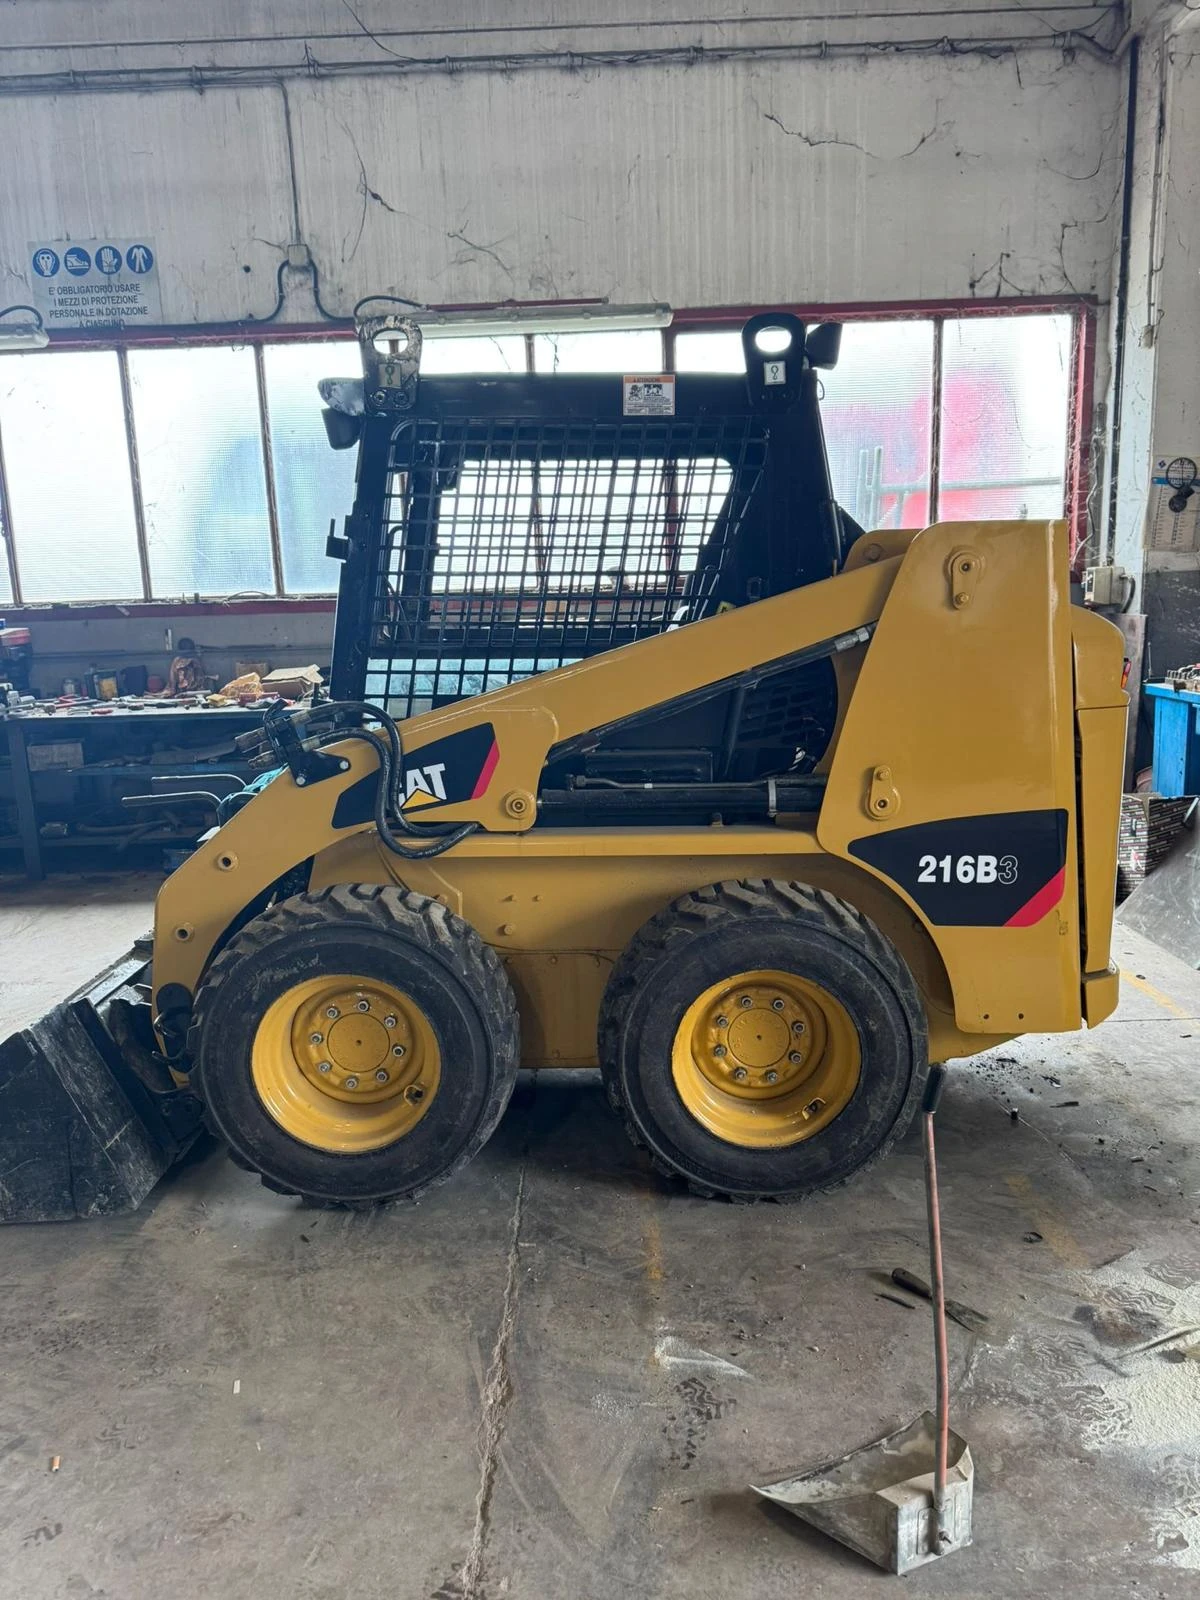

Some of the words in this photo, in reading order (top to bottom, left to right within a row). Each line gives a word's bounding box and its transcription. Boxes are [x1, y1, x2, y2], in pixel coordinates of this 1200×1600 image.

[57, 284, 113, 295] OBBLIGATORIO
[115, 283, 141, 293] USARE
[58, 297, 80, 306] MEZZI
[81, 297, 90, 306] DI
[91, 295, 139, 305] PROTEZIONE
[49, 309, 95, 318] PERSONALE
[96, 307, 104, 316] IN
[105, 306, 149, 316] DOTAZIONE
[399, 763, 447, 807] AT
[918, 855, 1018, 884] 216B3
